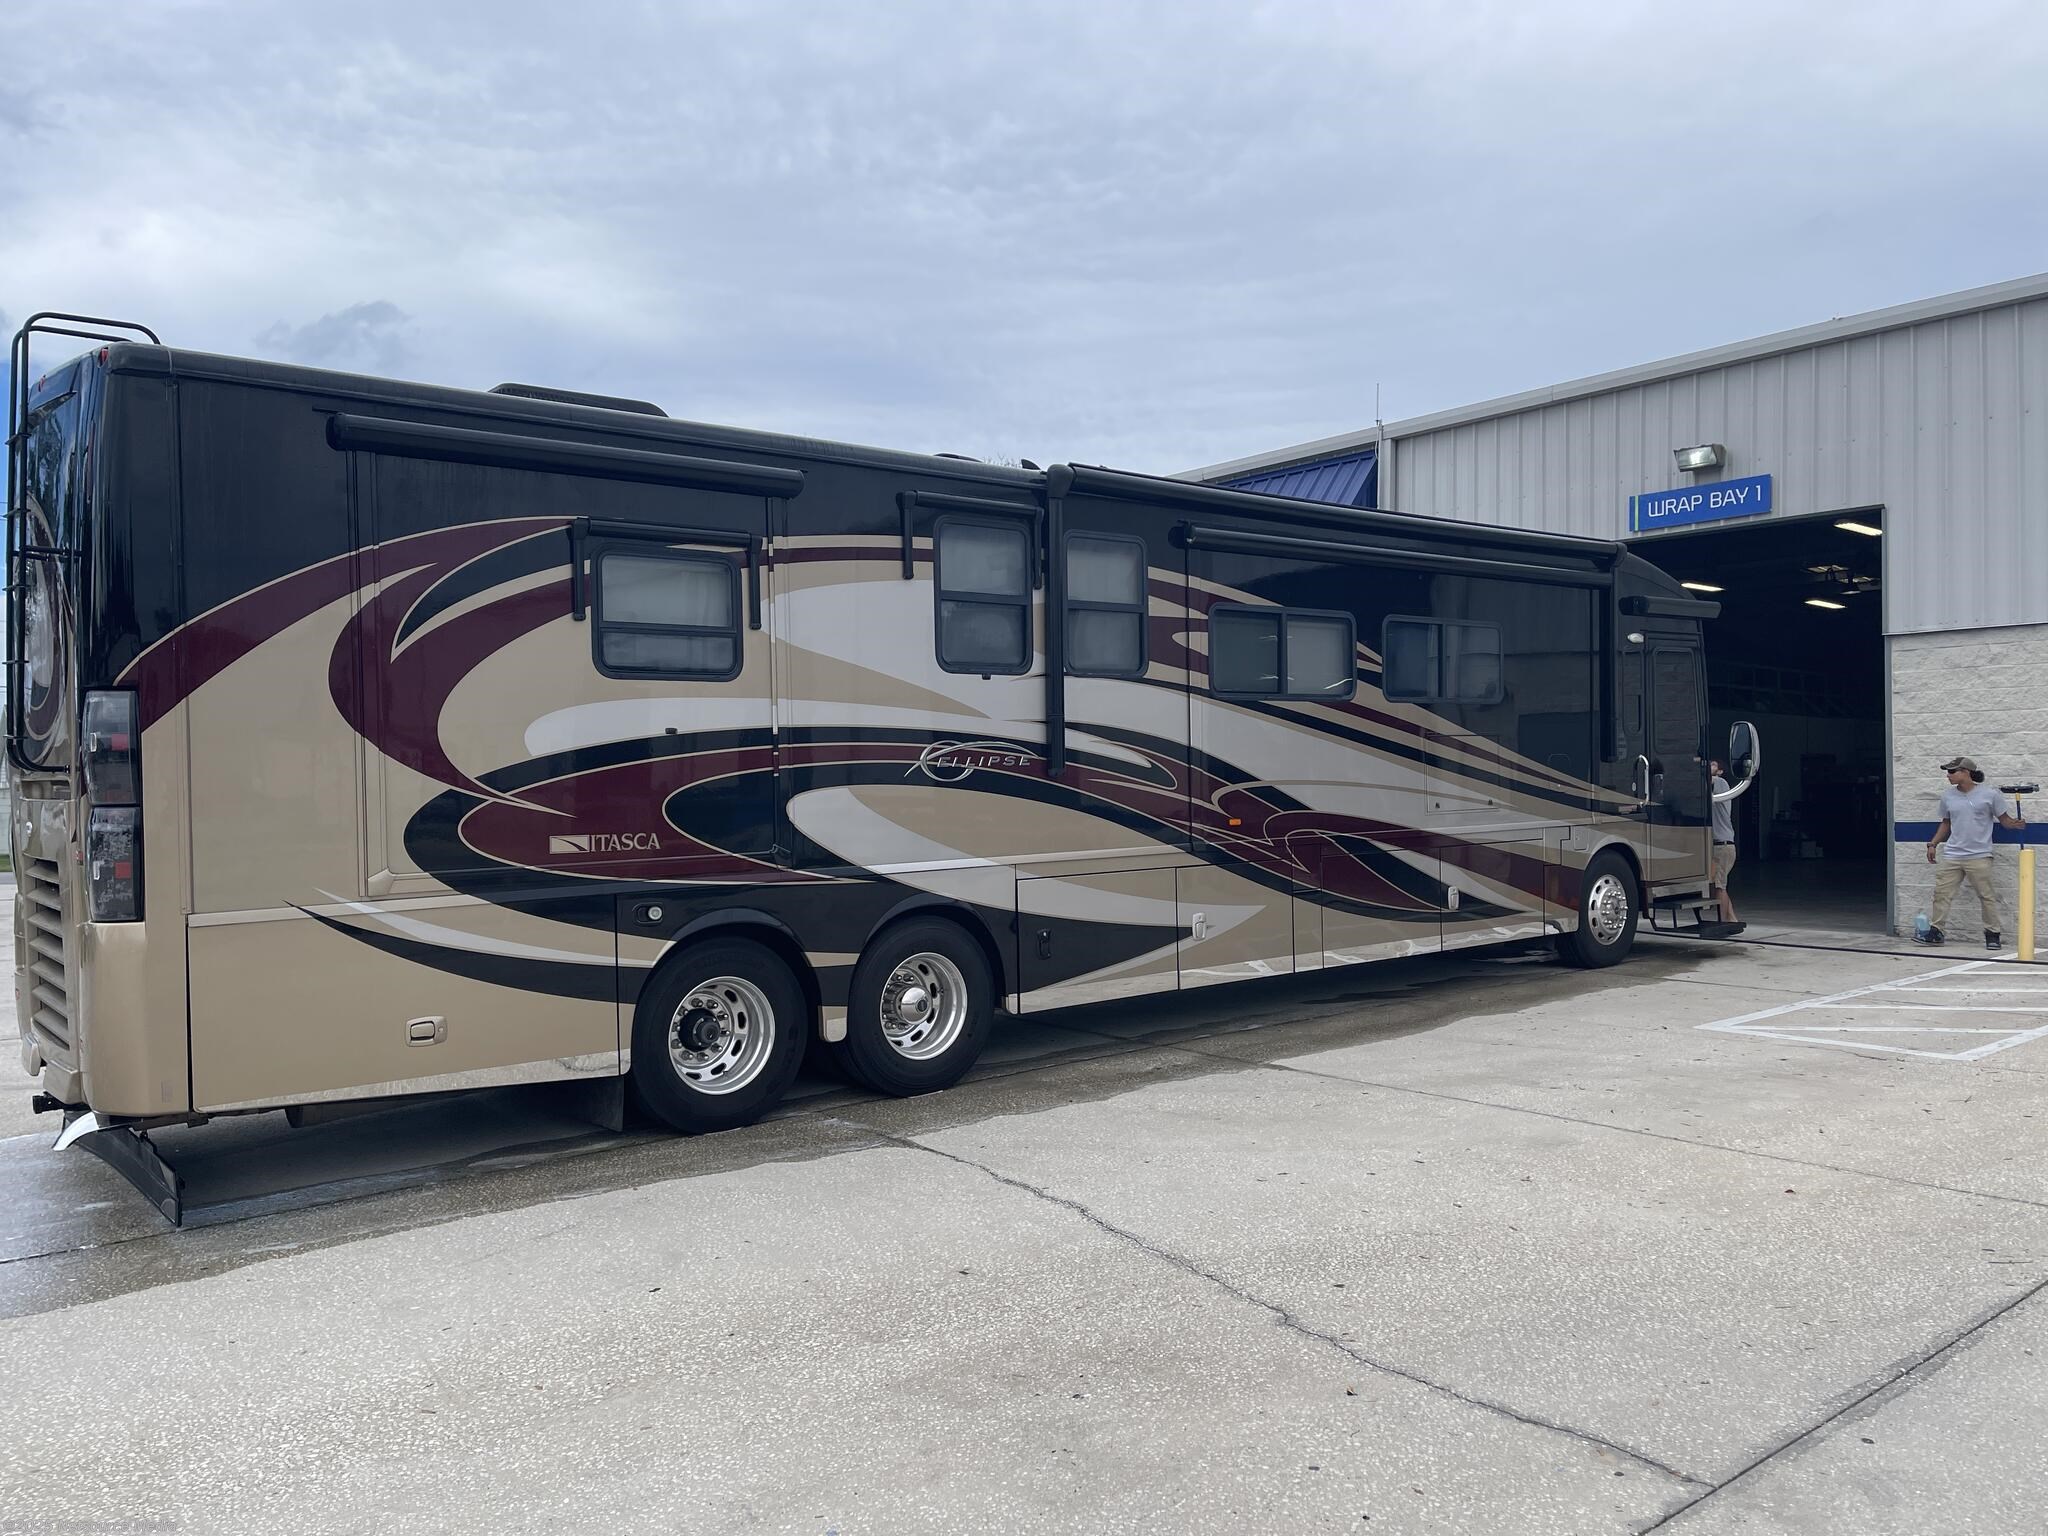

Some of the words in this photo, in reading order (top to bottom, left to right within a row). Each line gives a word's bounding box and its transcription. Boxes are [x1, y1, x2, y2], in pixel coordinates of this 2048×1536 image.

[1648, 495, 1703, 517] WRAP
[1710, 487, 1749, 508] BAY
[1755, 485, 1761, 501] 1
[936, 755, 1031, 768] ELLIPSE
[590, 833, 661, 852] ITASCA
